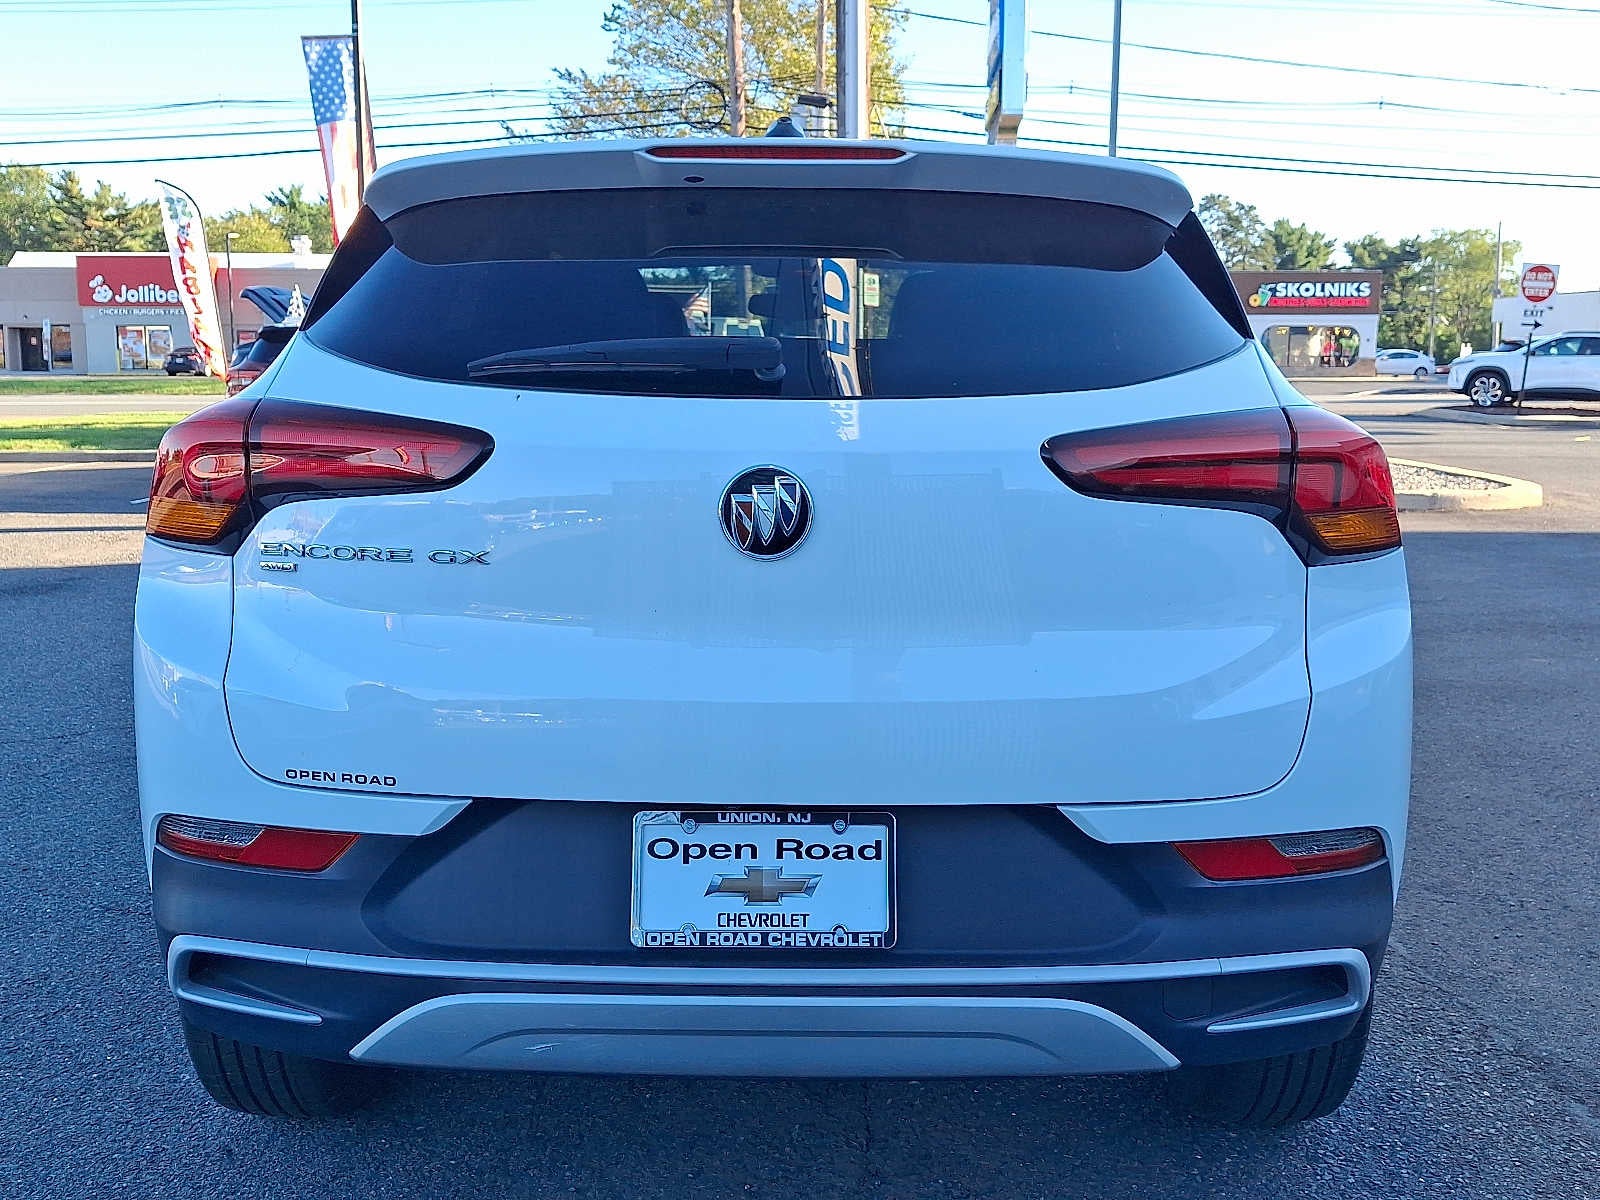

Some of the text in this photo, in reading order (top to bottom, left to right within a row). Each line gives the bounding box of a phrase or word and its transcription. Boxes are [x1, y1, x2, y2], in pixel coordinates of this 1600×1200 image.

[114, 283, 183, 303] Jollibe
[1275, 281, 1371, 297] SKOLNIKS
[1523, 309, 1544, 317] EXIT
[260, 542, 491, 566] ENCORE GX
[260, 562, 294, 572] AWD
[285, 769, 397, 787] OPEN ROAD
[717, 812, 812, 824] UNION, NJ
[647, 837, 882, 865] Open Road
[717, 912, 811, 928] CHEVROLET
[646, 931, 882, 948] OPEN ROAD CHEVROLET
